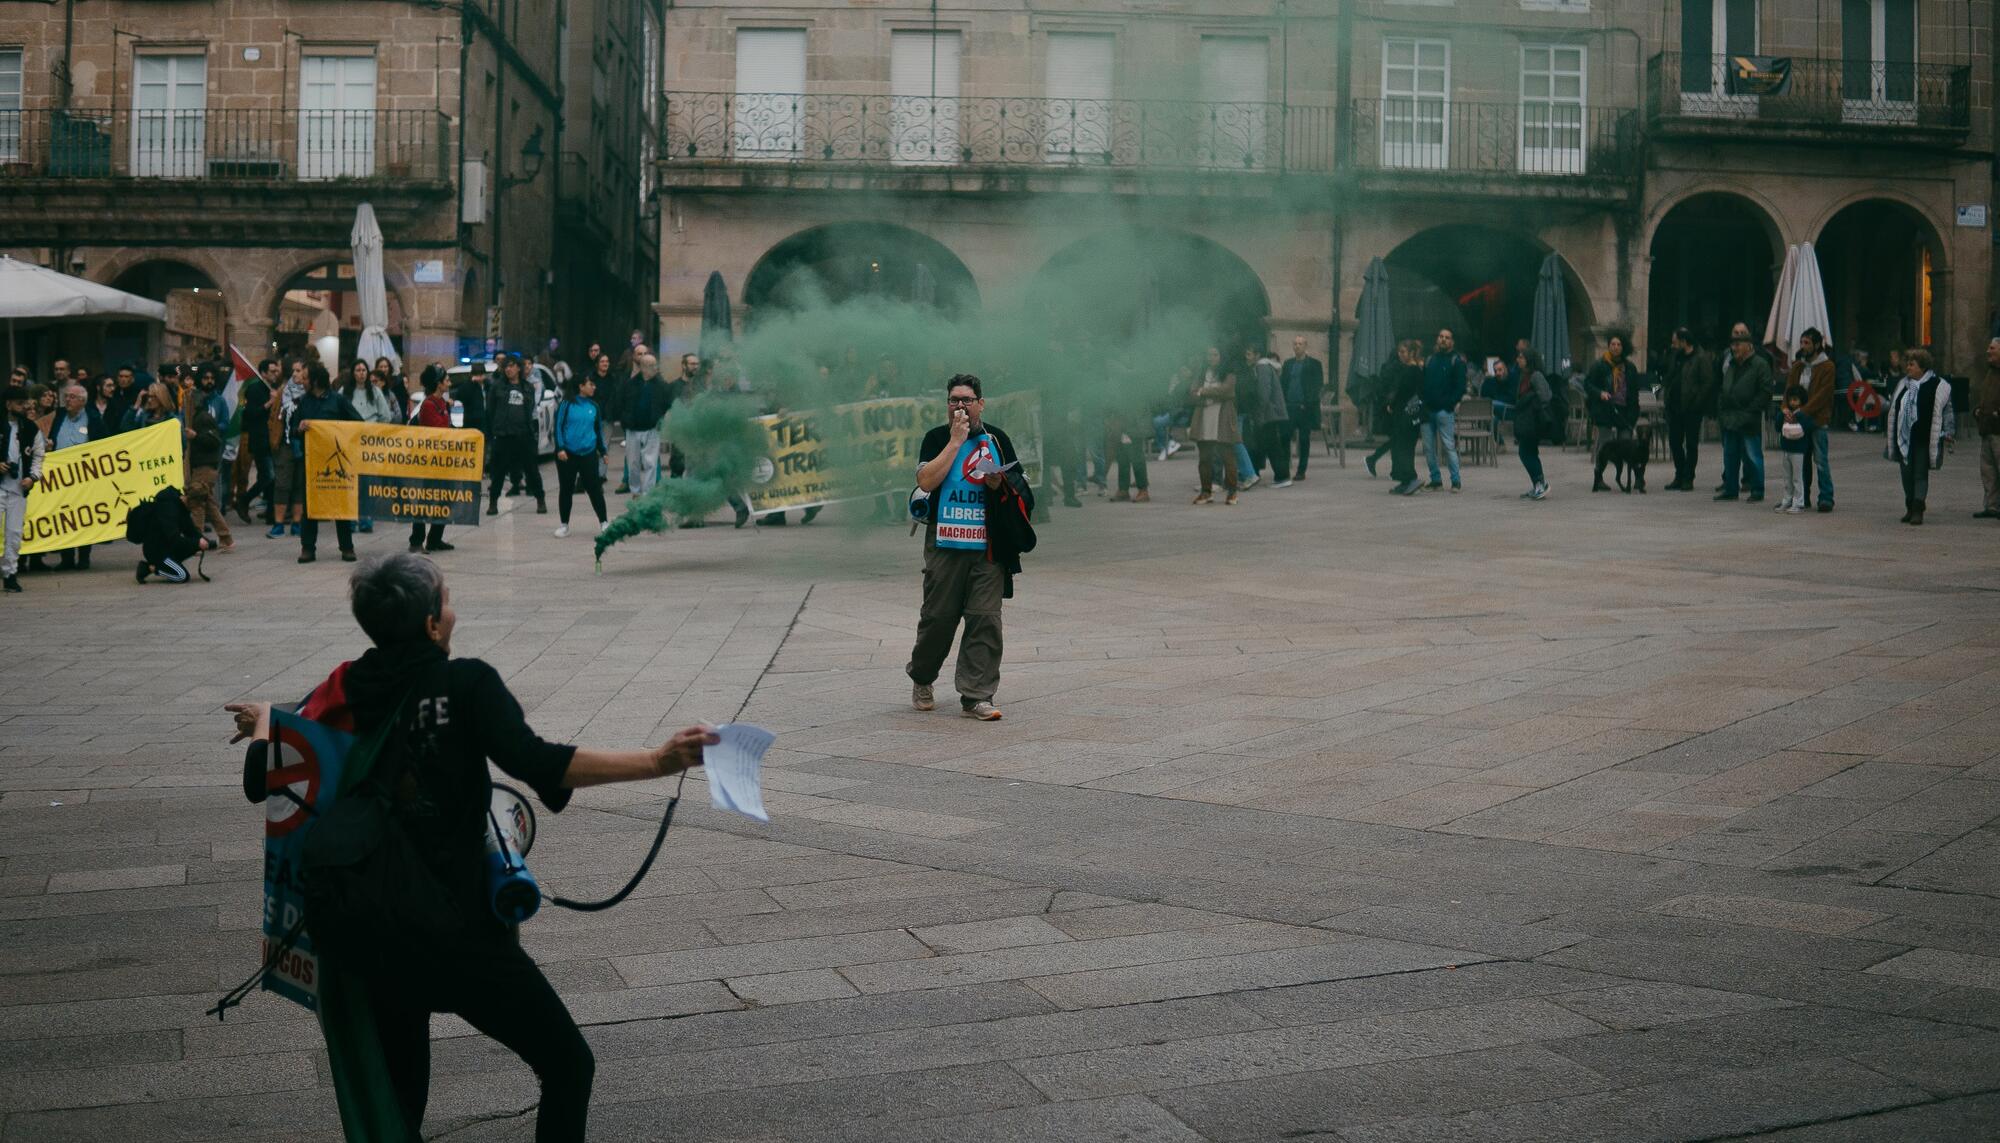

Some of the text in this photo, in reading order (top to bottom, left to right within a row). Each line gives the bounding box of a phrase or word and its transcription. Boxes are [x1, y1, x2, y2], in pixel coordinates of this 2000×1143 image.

[360, 434, 477, 453] SOMOS O PRESENTE
[139, 455, 175, 471] TERRA
[362, 451, 476, 469] DAS NOSAS ALDEAS
[40, 450, 132, 494] MUIÑOS
[153, 474, 167, 487] DE
[368, 484, 473, 502] IMOS CONSERVAR
[948, 489, 986, 505] ALDE
[391, 504, 450, 518] O FUTURO
[22, 502, 111, 542] UCIÑOS
[939, 526, 987, 540] MACROEÓL
